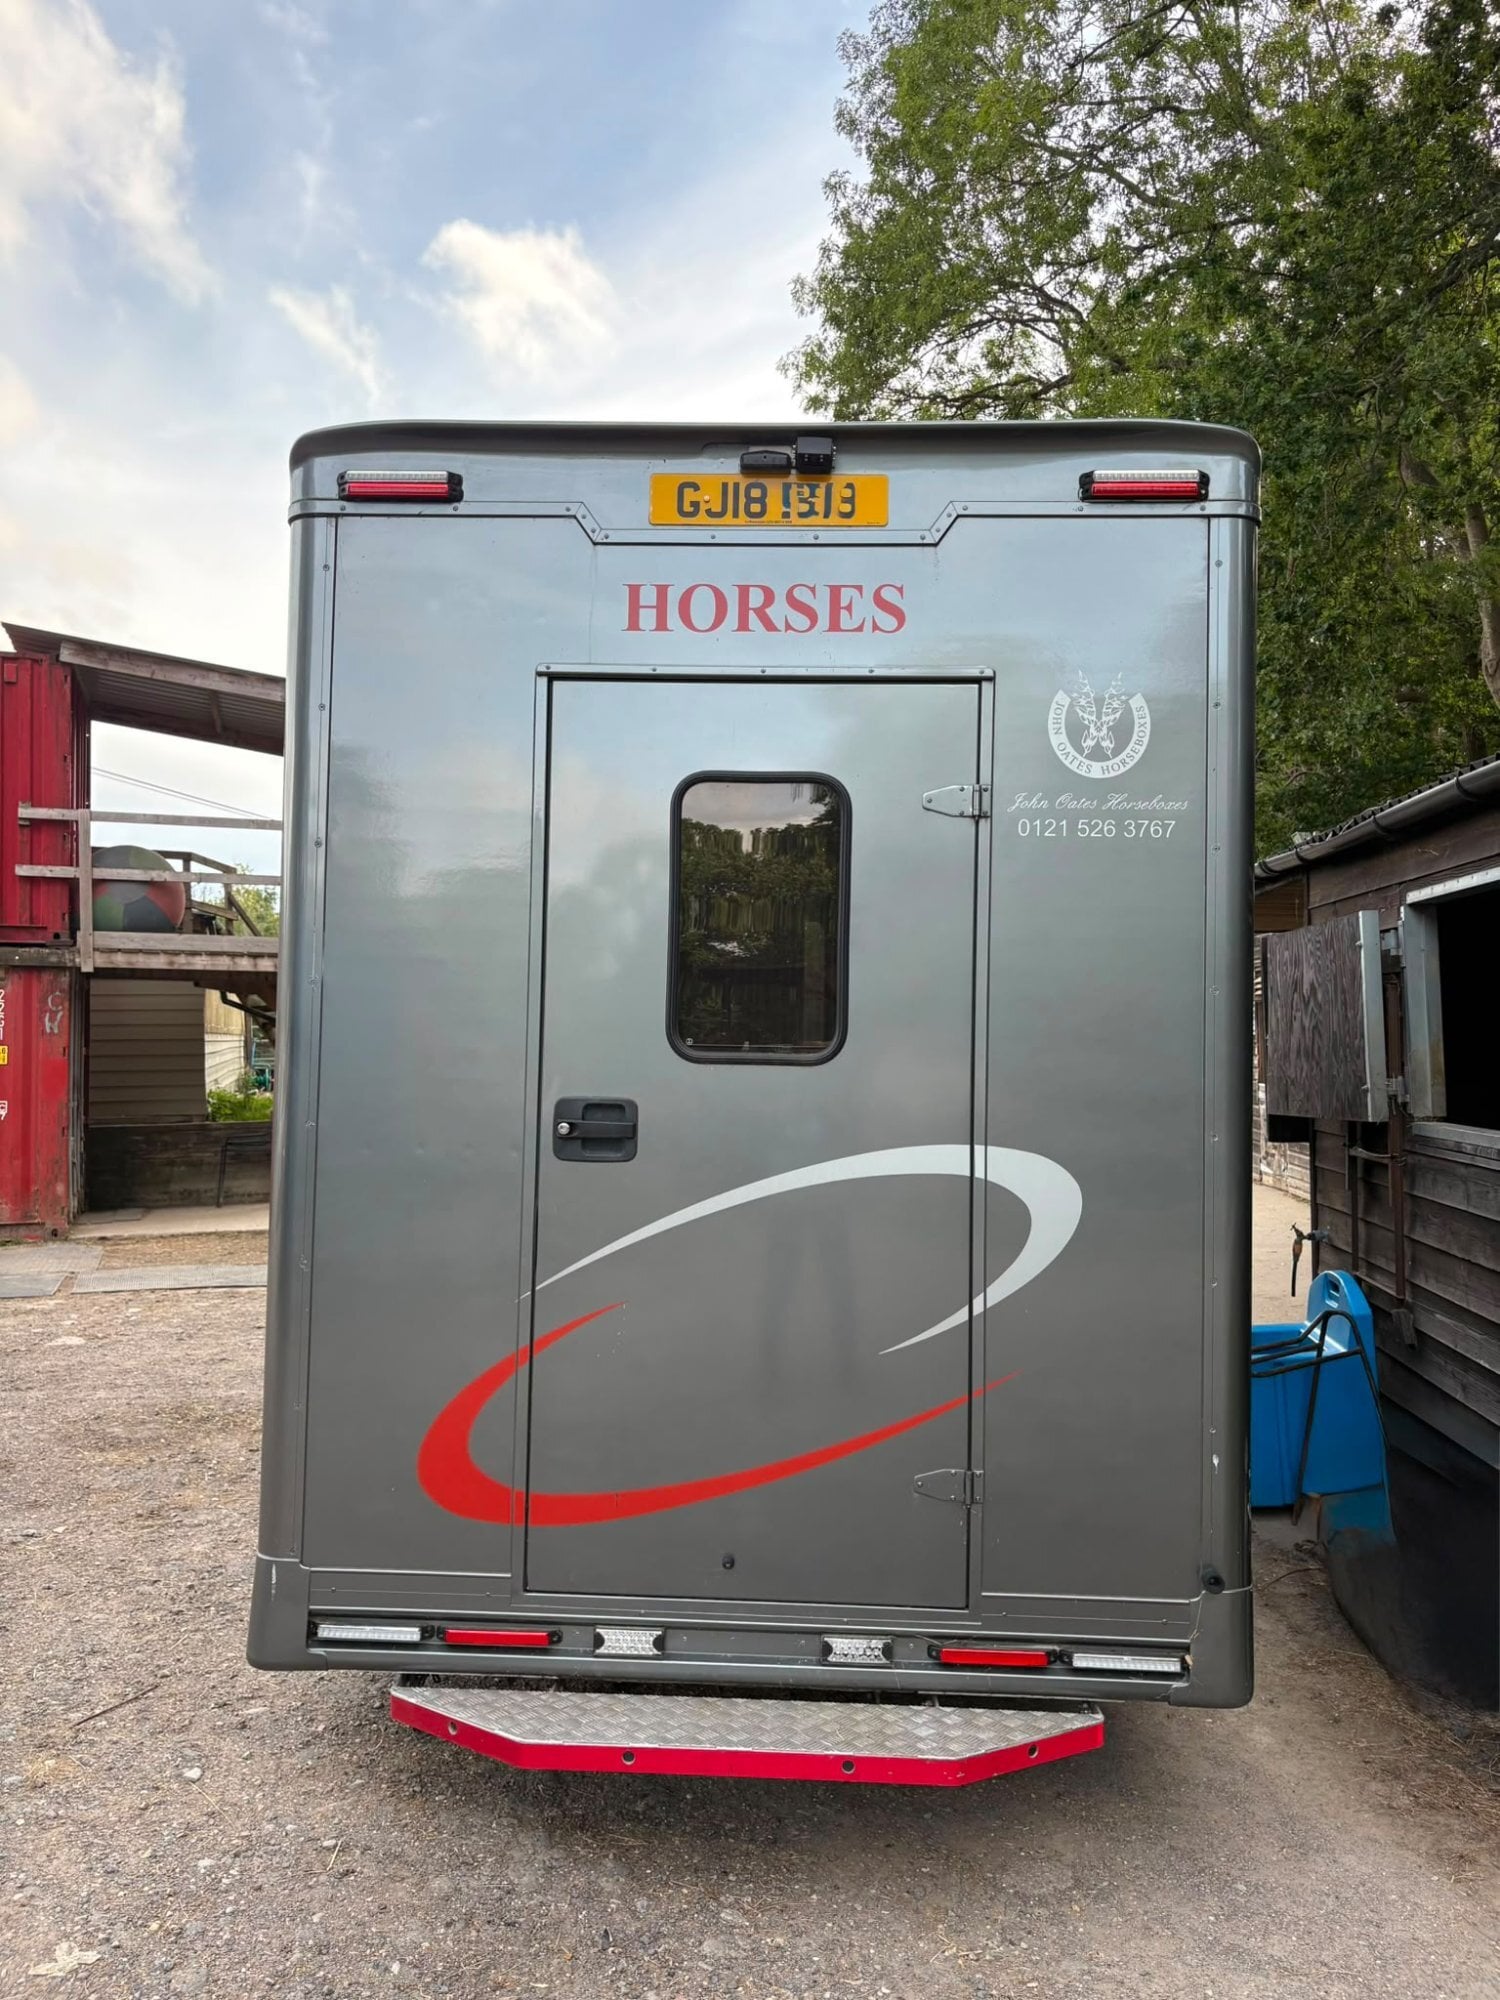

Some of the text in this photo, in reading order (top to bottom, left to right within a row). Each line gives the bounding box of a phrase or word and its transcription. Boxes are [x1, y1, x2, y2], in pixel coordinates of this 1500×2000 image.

[621, 583, 907, 633] HORSES
[1052, 700, 1148, 775] JOHN OATES HORSEBOXES
[1007, 792, 1188, 812] John Oates Horseboxes
[1018, 818, 1176, 838] 0121 526 3767
